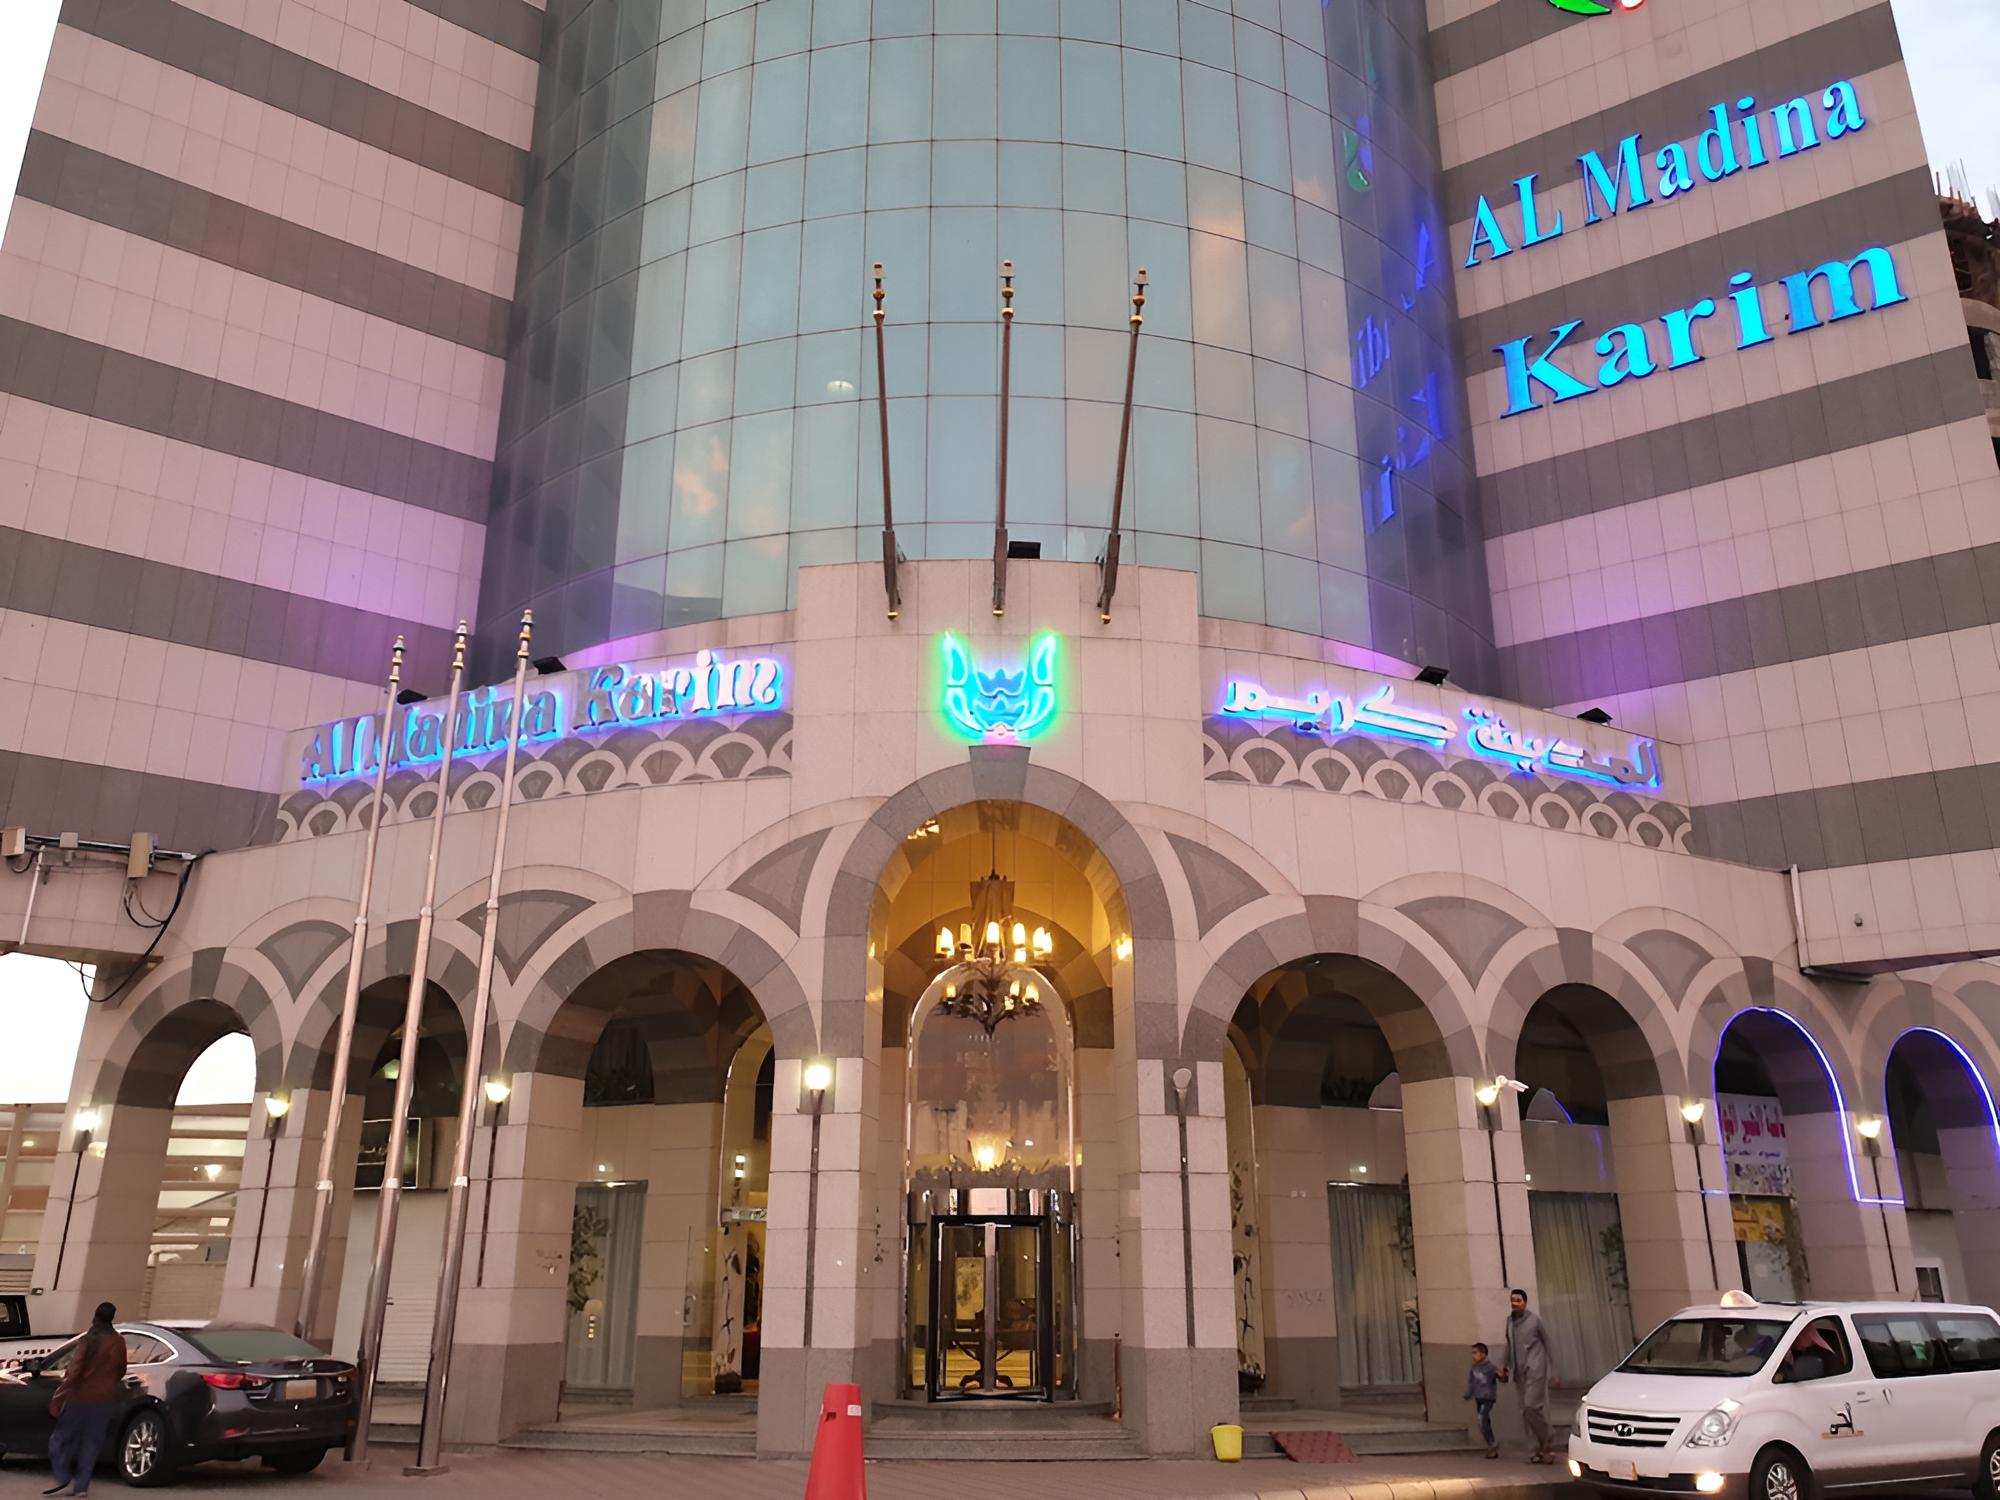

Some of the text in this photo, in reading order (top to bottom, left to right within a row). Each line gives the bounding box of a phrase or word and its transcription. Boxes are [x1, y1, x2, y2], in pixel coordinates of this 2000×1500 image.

[1463, 79, 1865, 269] AL Madina
[1492, 246, 1908, 418] Karim
[572, 651, 782, 730] Karim
[1222, 681, 1457, 746] كريم
